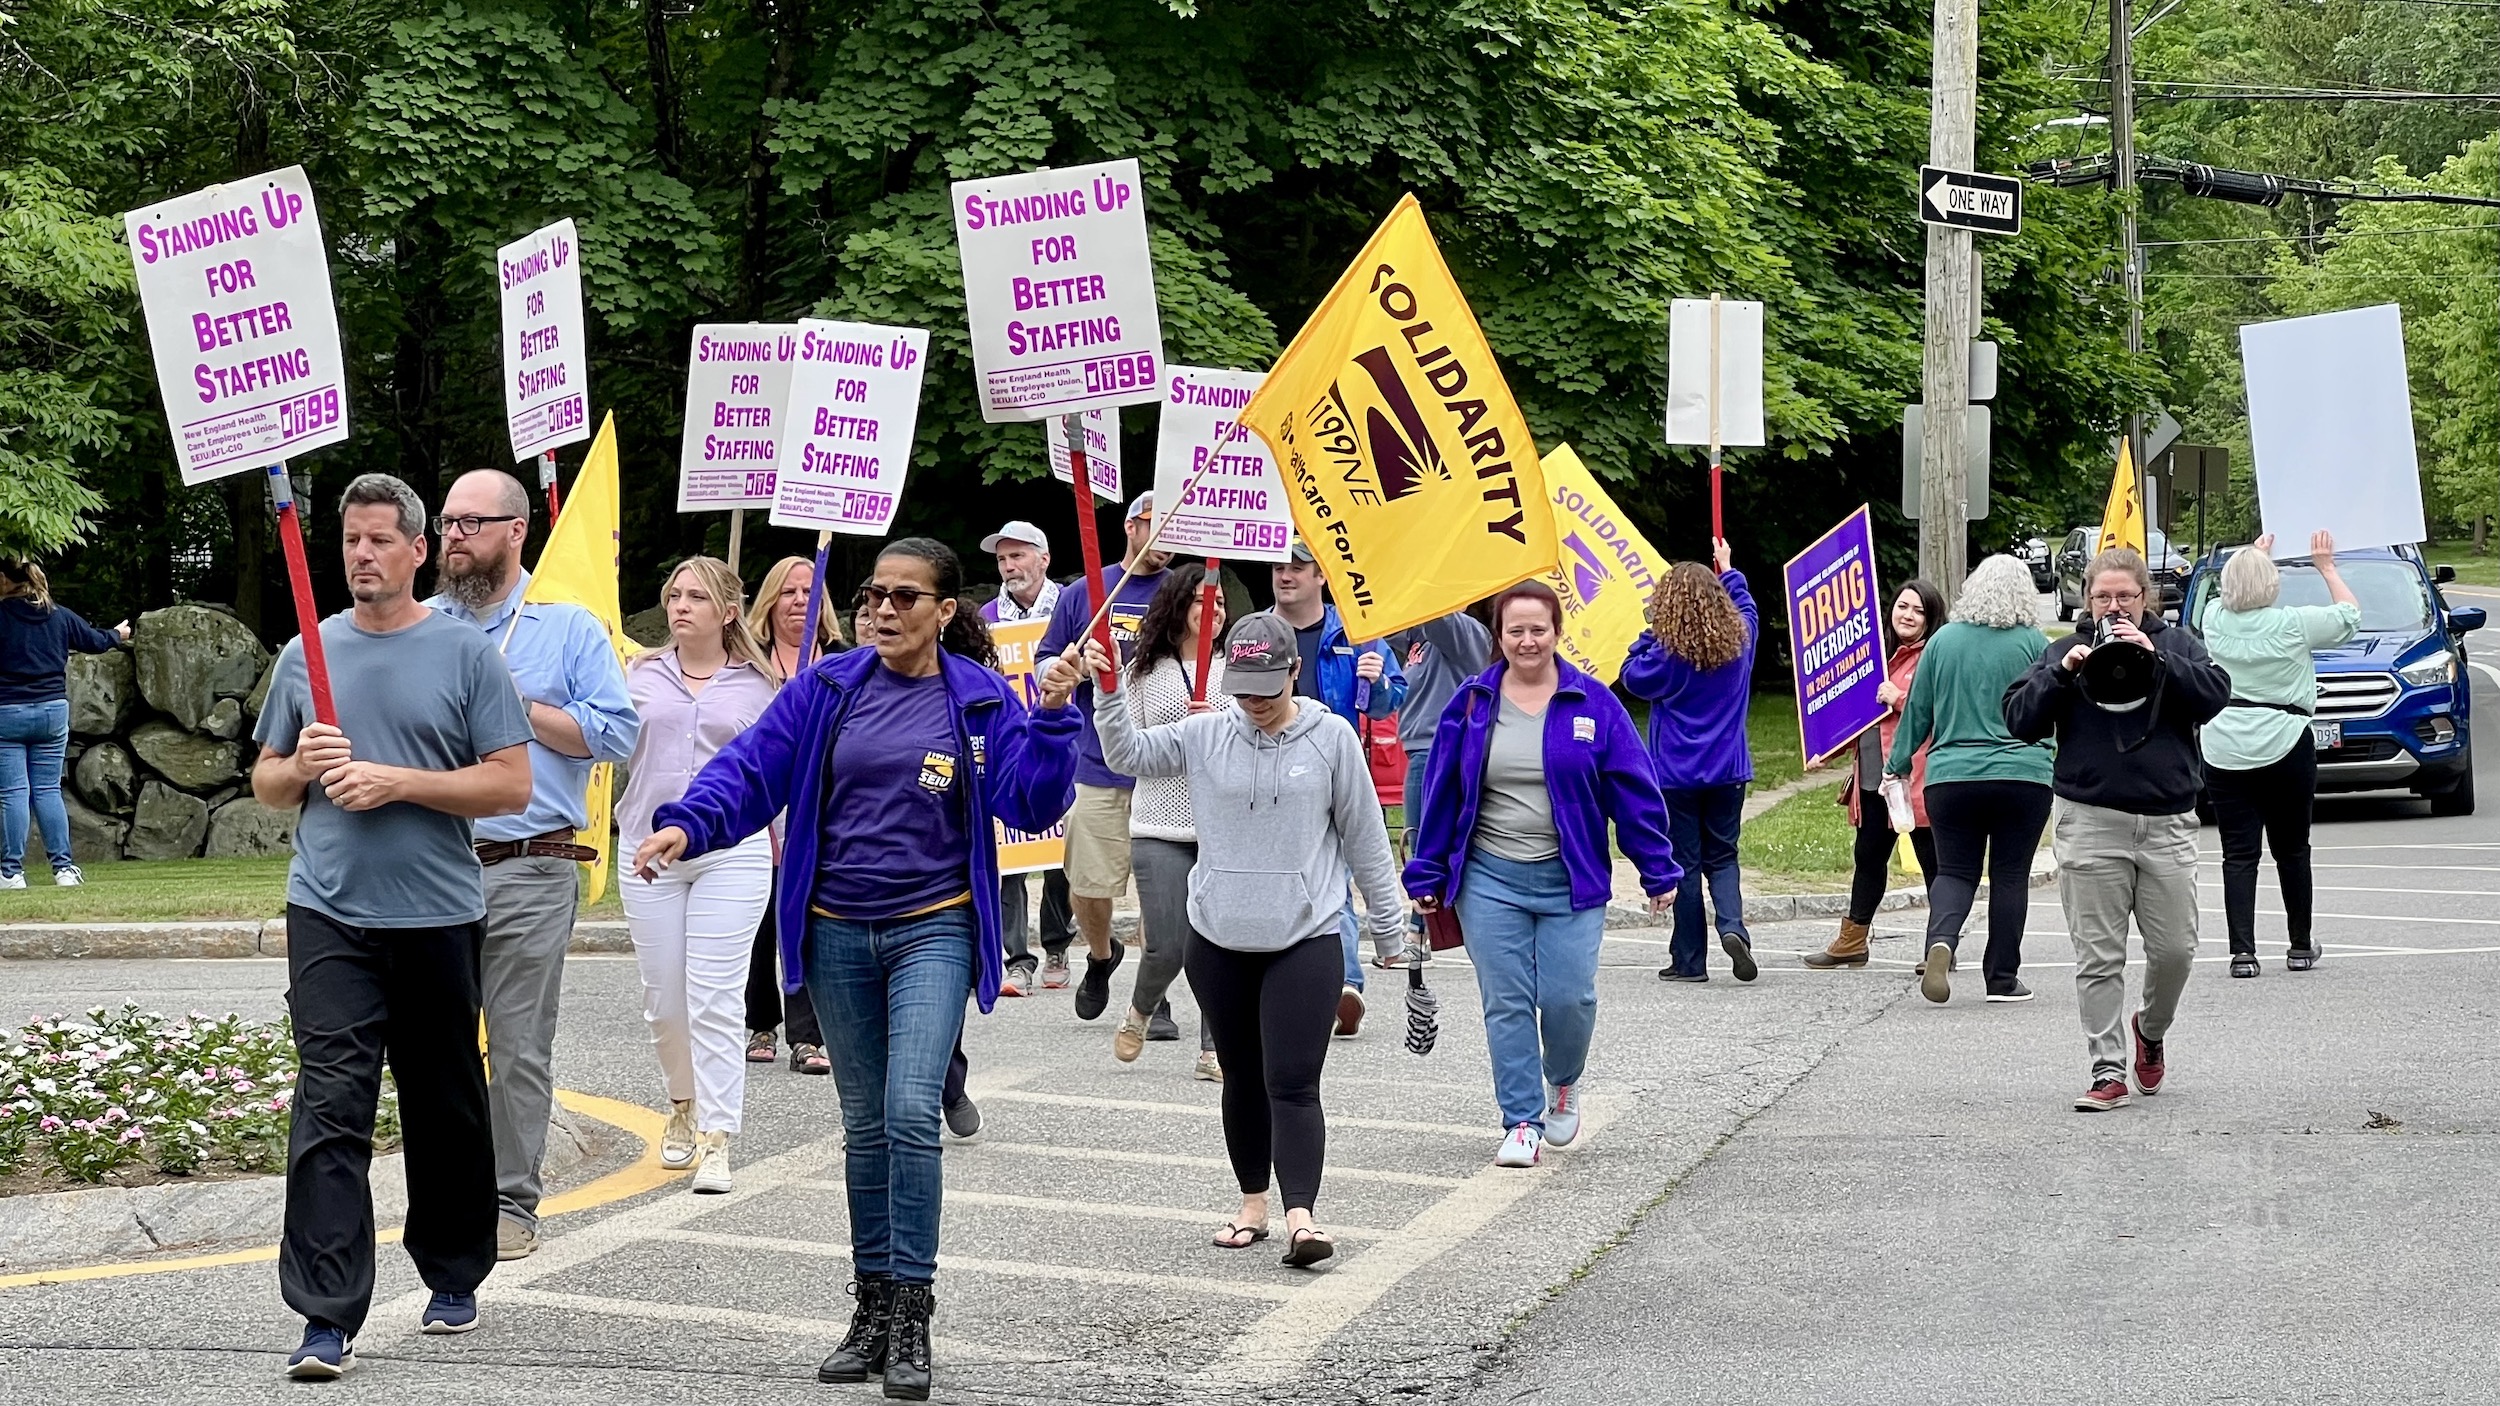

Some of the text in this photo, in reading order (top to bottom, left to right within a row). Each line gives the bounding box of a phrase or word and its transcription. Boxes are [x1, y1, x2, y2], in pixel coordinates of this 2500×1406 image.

[965, 177, 1130, 230] STANDING UP
[1949, 188, 2008, 215] ONE WAY
[138, 188, 302, 264] STANDING UP
[503, 236, 568, 290] STANDING UP
[1031, 235, 1077, 265] FOR
[205, 260, 256, 298] FOR
[1012, 275, 1106, 311] BETTER
[526, 290, 544, 319] FOR
[193, 302, 292, 352] BETTER
[520, 325, 559, 361] BETTER
[1007, 316, 1121, 356] STAFFING
[698, 336, 772, 362] STANDING
[802, 331, 917, 370] STANDING UP
[194, 348, 310, 404] STAFFING
[518, 362, 566, 400] STAFFING
[731, 375, 759, 394] FOR
[834, 378, 868, 403] FOR
[988, 368, 1071, 386] New England Health
[990, 378, 1084, 395] Care Employees Union,
[1170, 377, 1257, 409] STANDIN
[184, 413, 266, 440] New England Health
[714, 402, 771, 427] BETTER
[814, 407, 879, 442] BETTER
[188, 442, 206, 452] Care
[208, 430, 252, 446] Employees
[704, 434, 774, 460] STAFFING
[1214, 421, 1249, 443] FOR
[802, 443, 880, 480] STAFFING
[1193, 446, 1263, 477] BETTER
[744, 473, 777, 496] 119
[1182, 479, 1268, 510] STAFFING
[1176, 518, 1202, 526] England
[1326, 520, 1355, 564] For
[1798, 559, 1866, 648] DRUG
[1563, 636, 1598, 676] For All
[1802, 608, 1872, 676] OVERDOSE
[1806, 681, 1815, 698] IN
[1816, 668, 1835, 692] 2021
[1835, 652, 1856, 678] THAN
[1807, 692, 1828, 716] OTHER
[1856, 659, 1874, 682] YEAR
[918, 772, 952, 788] SEIU
